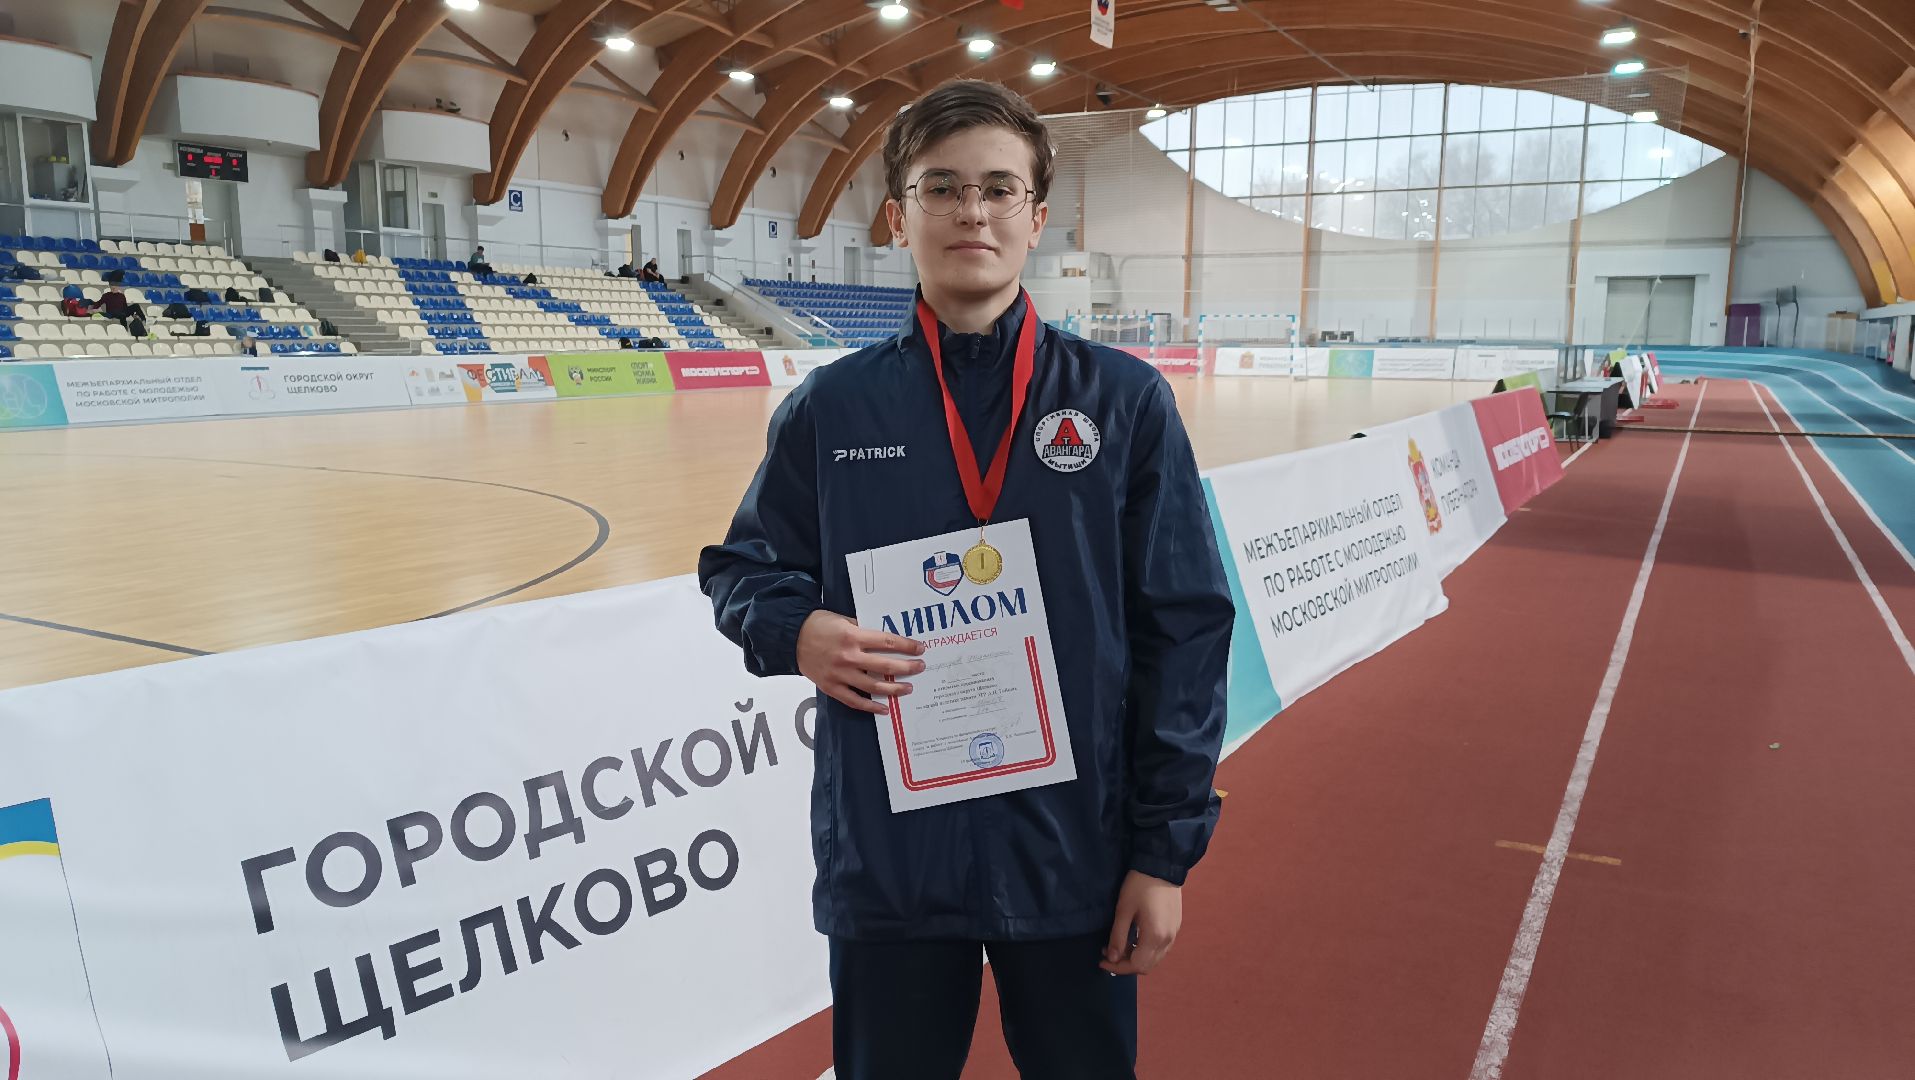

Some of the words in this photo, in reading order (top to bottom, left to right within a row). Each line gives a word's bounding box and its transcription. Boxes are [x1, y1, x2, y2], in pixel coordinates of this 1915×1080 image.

[511, 192, 520, 206] C
[66, 376, 171, 388] МЕЖЪЕПАРХИАЛЬНЫЙ
[283, 371, 343, 383] ГОРОДСКОЙ
[345, 373, 374, 381] ОКРУГ
[76, 390, 90, 398] ПО
[93, 388, 128, 397] РАБОТЕ
[138, 385, 199, 394] МОЛОДЕЖЬЮ
[286, 385, 338, 394] ЩЕЛКОВО
[75, 398, 141, 408] МОСКОВСКОЙ
[143, 394, 205, 404] МИТРОПОЛИИ
[849, 445, 906, 461] PATRICK
[1043, 445, 1092, 458] АВАНГАРД
[1047, 459, 1087, 470] МЫТИЩИ
[1243, 499, 1371, 563] МЕЖЪЕПАРХИАЛЬНЫЙ
[1372, 493, 1403, 518] ОТДЕЛ
[1263, 572, 1285, 598] ПО
[1287, 552, 1335, 589] РАБОТЕ
[1334, 549, 1344, 568] С
[1344, 524, 1407, 565] МОЛОДЕЖЬЮ
[1270, 578, 1355, 638] МОСКОВСКОЙ
[1354, 552, 1420, 597] МИТРОПОЛИИ
[921, 627, 998, 649] АГРАЖДАЕТСЯ
[240, 697, 779, 936] ГОРОДСКОЙ
[270, 828, 740, 1063] ЩЕЛКОВО
